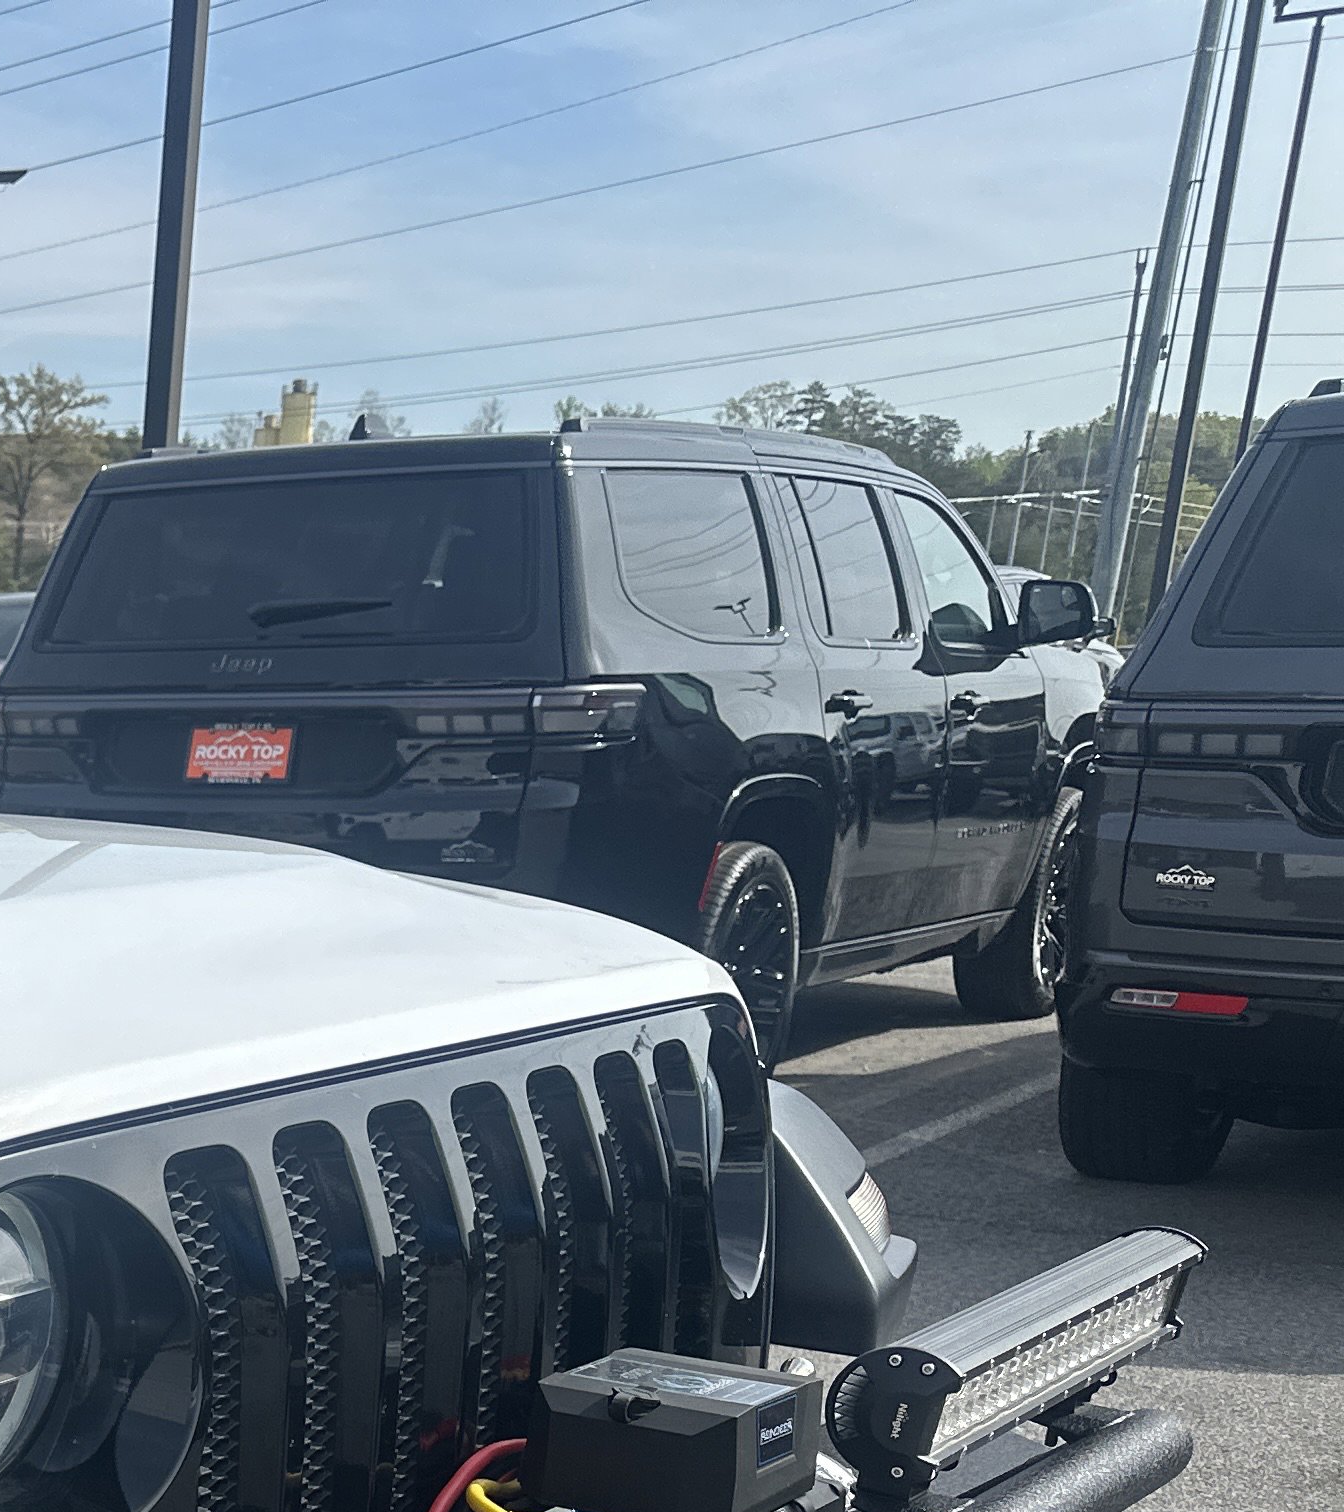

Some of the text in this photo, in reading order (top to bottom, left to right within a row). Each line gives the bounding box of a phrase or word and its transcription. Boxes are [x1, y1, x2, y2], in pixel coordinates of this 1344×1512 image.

[211, 654, 273, 674] Jeep
[194, 745, 284, 760] ROCKY TOP
[1155, 872, 1192, 884] ROCKY
[1192, 876, 1215, 886] TOP
[890, 1403, 909, 1439] Nilight
